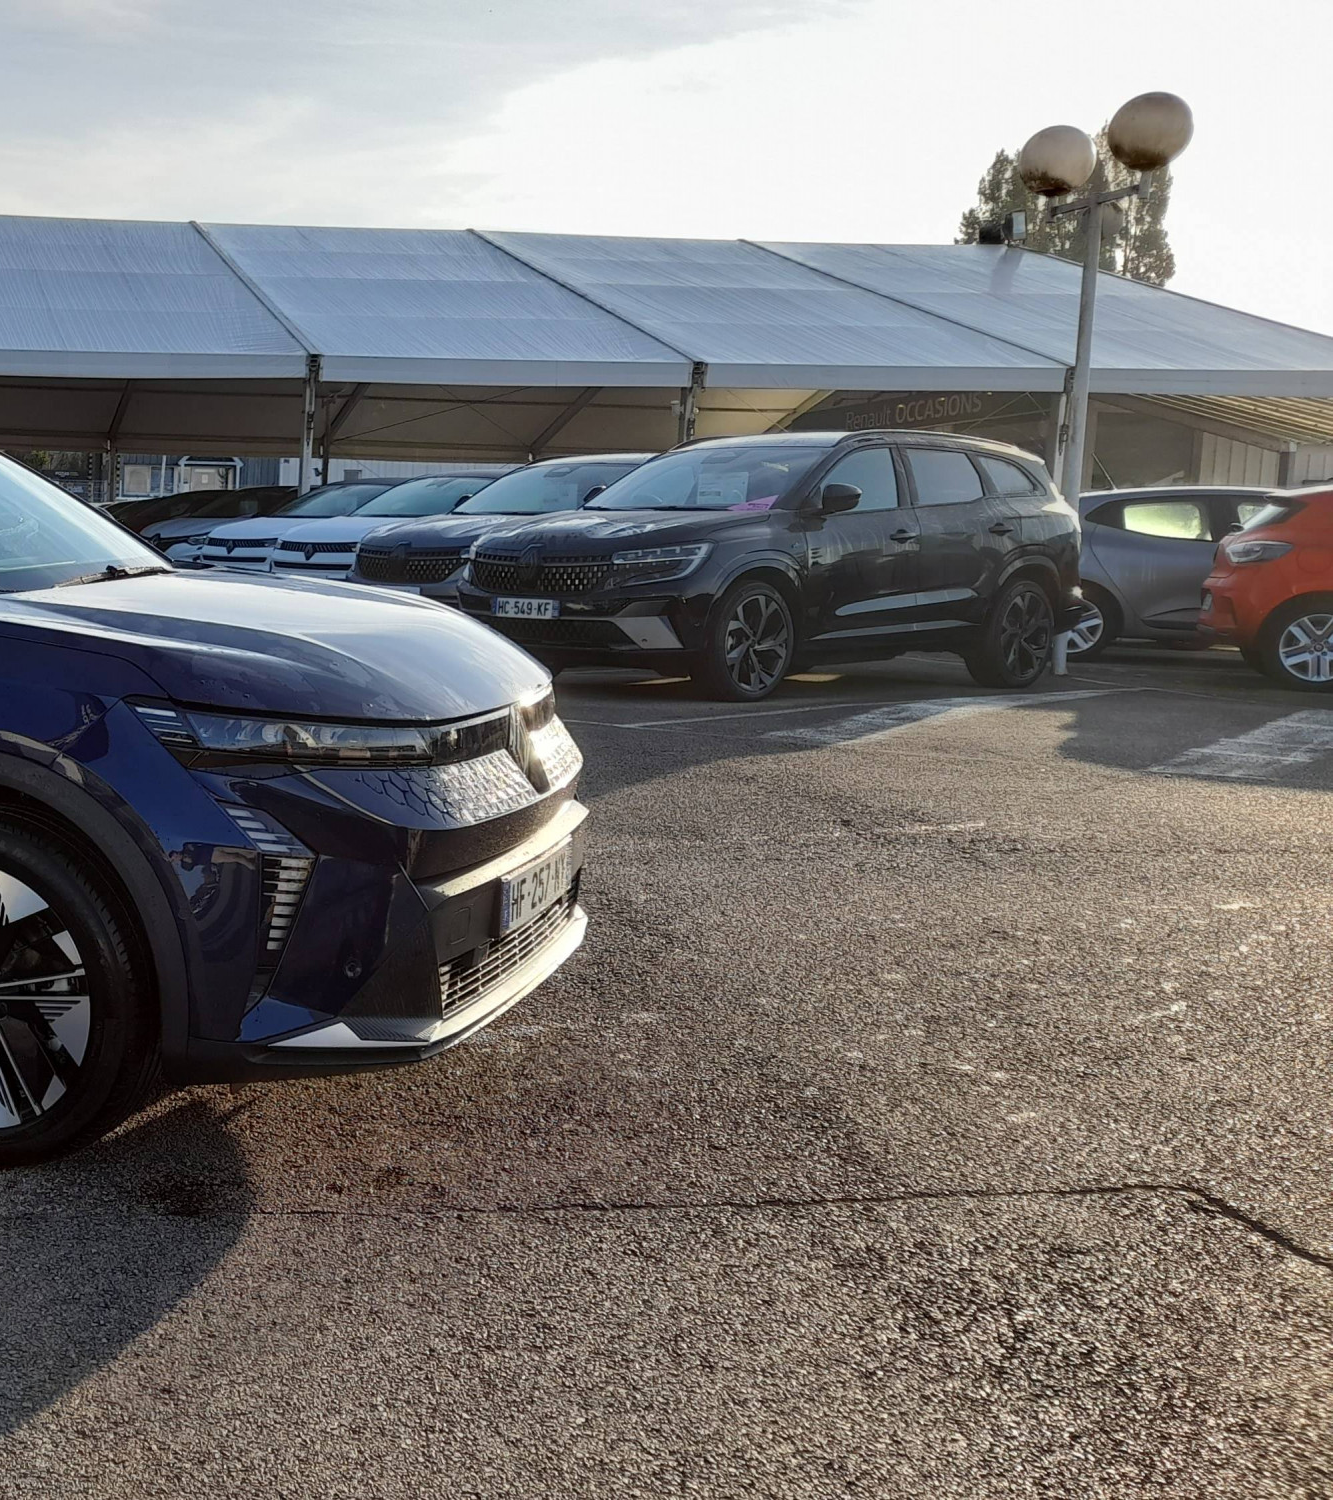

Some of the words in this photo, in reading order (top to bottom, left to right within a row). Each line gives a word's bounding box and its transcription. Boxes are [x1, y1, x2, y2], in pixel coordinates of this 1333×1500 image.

[845, 406, 891, 431] Renault
[895, 393, 983, 424] OCCASIONS
[497, 600, 551, 617] HC-549-KF
